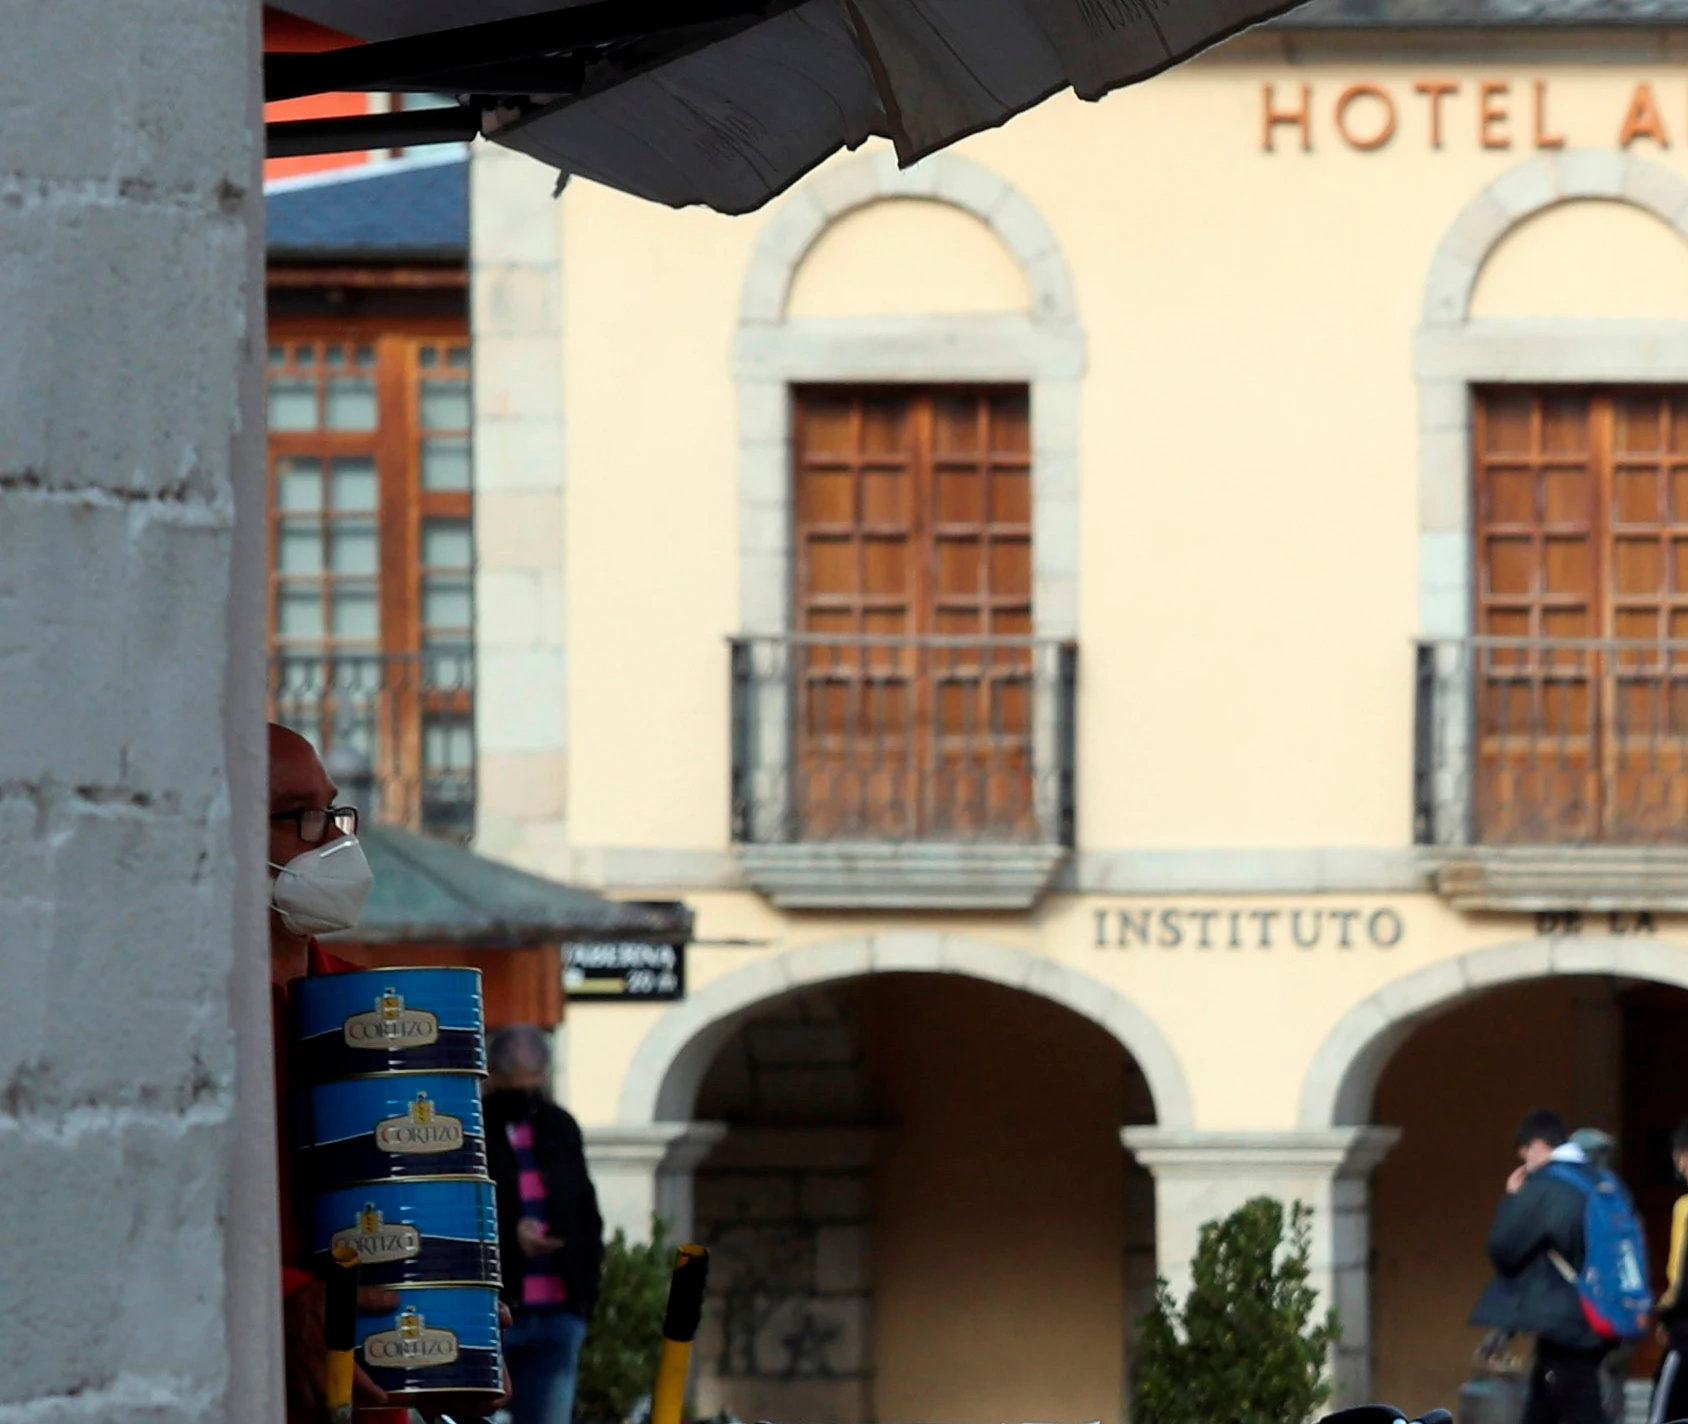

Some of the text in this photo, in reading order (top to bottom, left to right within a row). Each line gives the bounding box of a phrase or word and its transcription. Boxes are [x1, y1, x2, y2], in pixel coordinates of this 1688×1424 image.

[1260, 78, 1566, 153] HOTEL
[1093, 908, 1405, 949] INSTITUTO
[349, 1020, 433, 1040] CORTIZO
[380, 1125, 459, 1144] CORTIZO
[370, 1340, 452, 1359] CORTIZO
